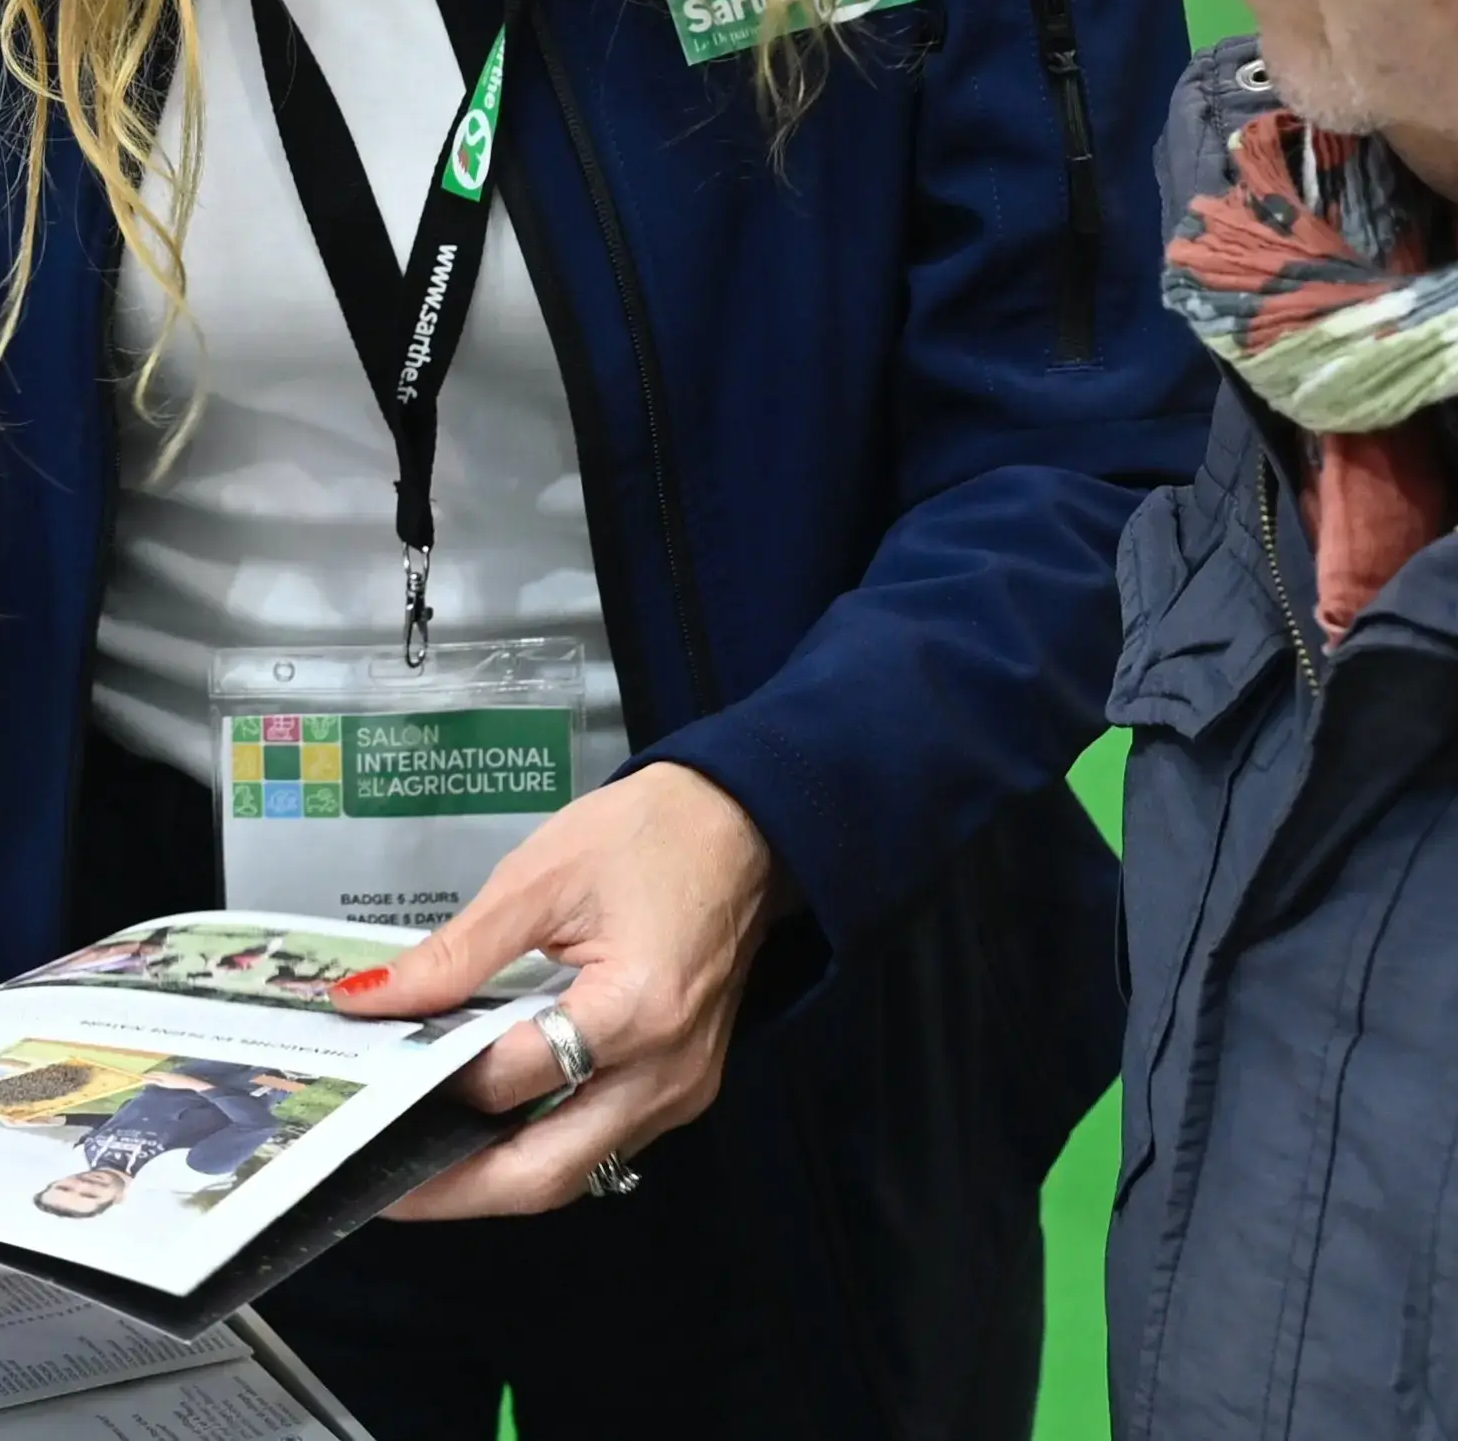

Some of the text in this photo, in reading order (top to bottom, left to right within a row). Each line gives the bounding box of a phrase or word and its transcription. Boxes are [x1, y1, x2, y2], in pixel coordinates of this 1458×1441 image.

[396, 244, 458, 405] www.sarthe.fr
[356, 725, 440, 748] SALON
[356, 747, 557, 774] INTERNATIONAL
[372, 770, 558, 798] L'AGRICULTURE
[340, 893, 394, 906] BADGE
[409, 892, 460, 904] JOURS
